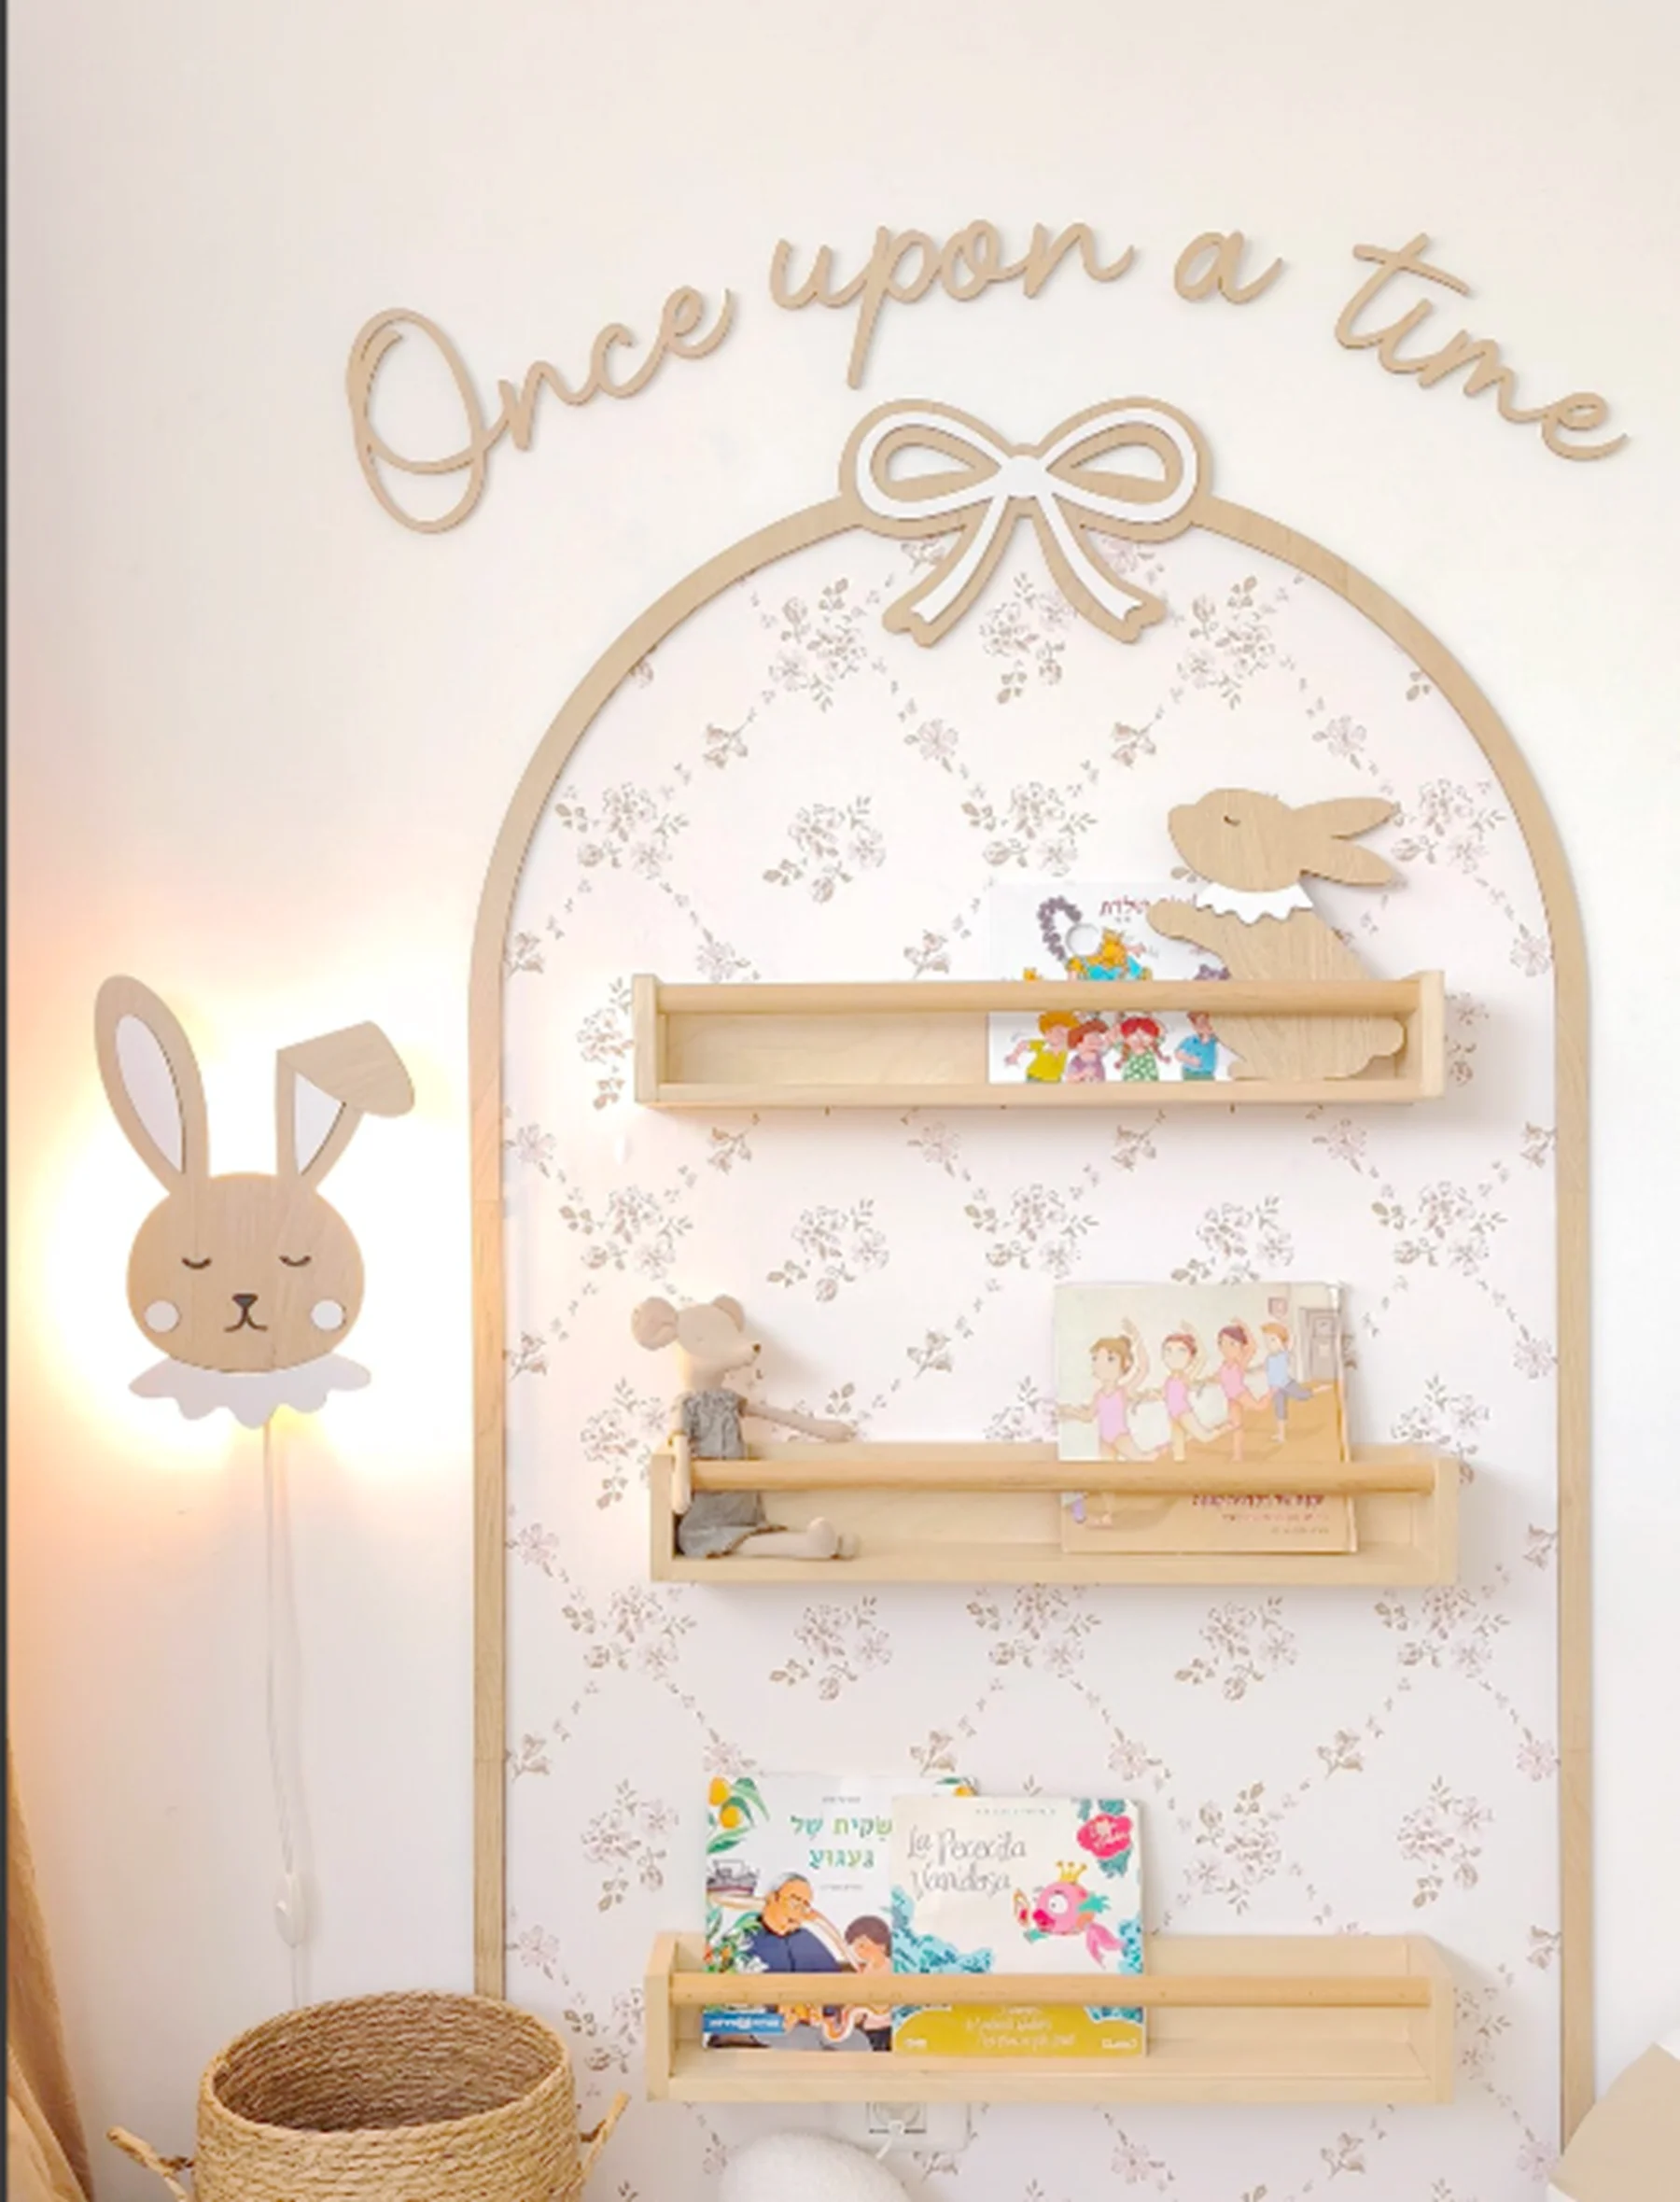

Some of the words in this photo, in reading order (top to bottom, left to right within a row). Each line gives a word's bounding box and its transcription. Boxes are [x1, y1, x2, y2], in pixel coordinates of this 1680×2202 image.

[346, 287, 736, 536] Once
[769, 218, 1135, 390] upon
[1173, 229, 1285, 305] a
[1333, 231, 1630, 462] time
